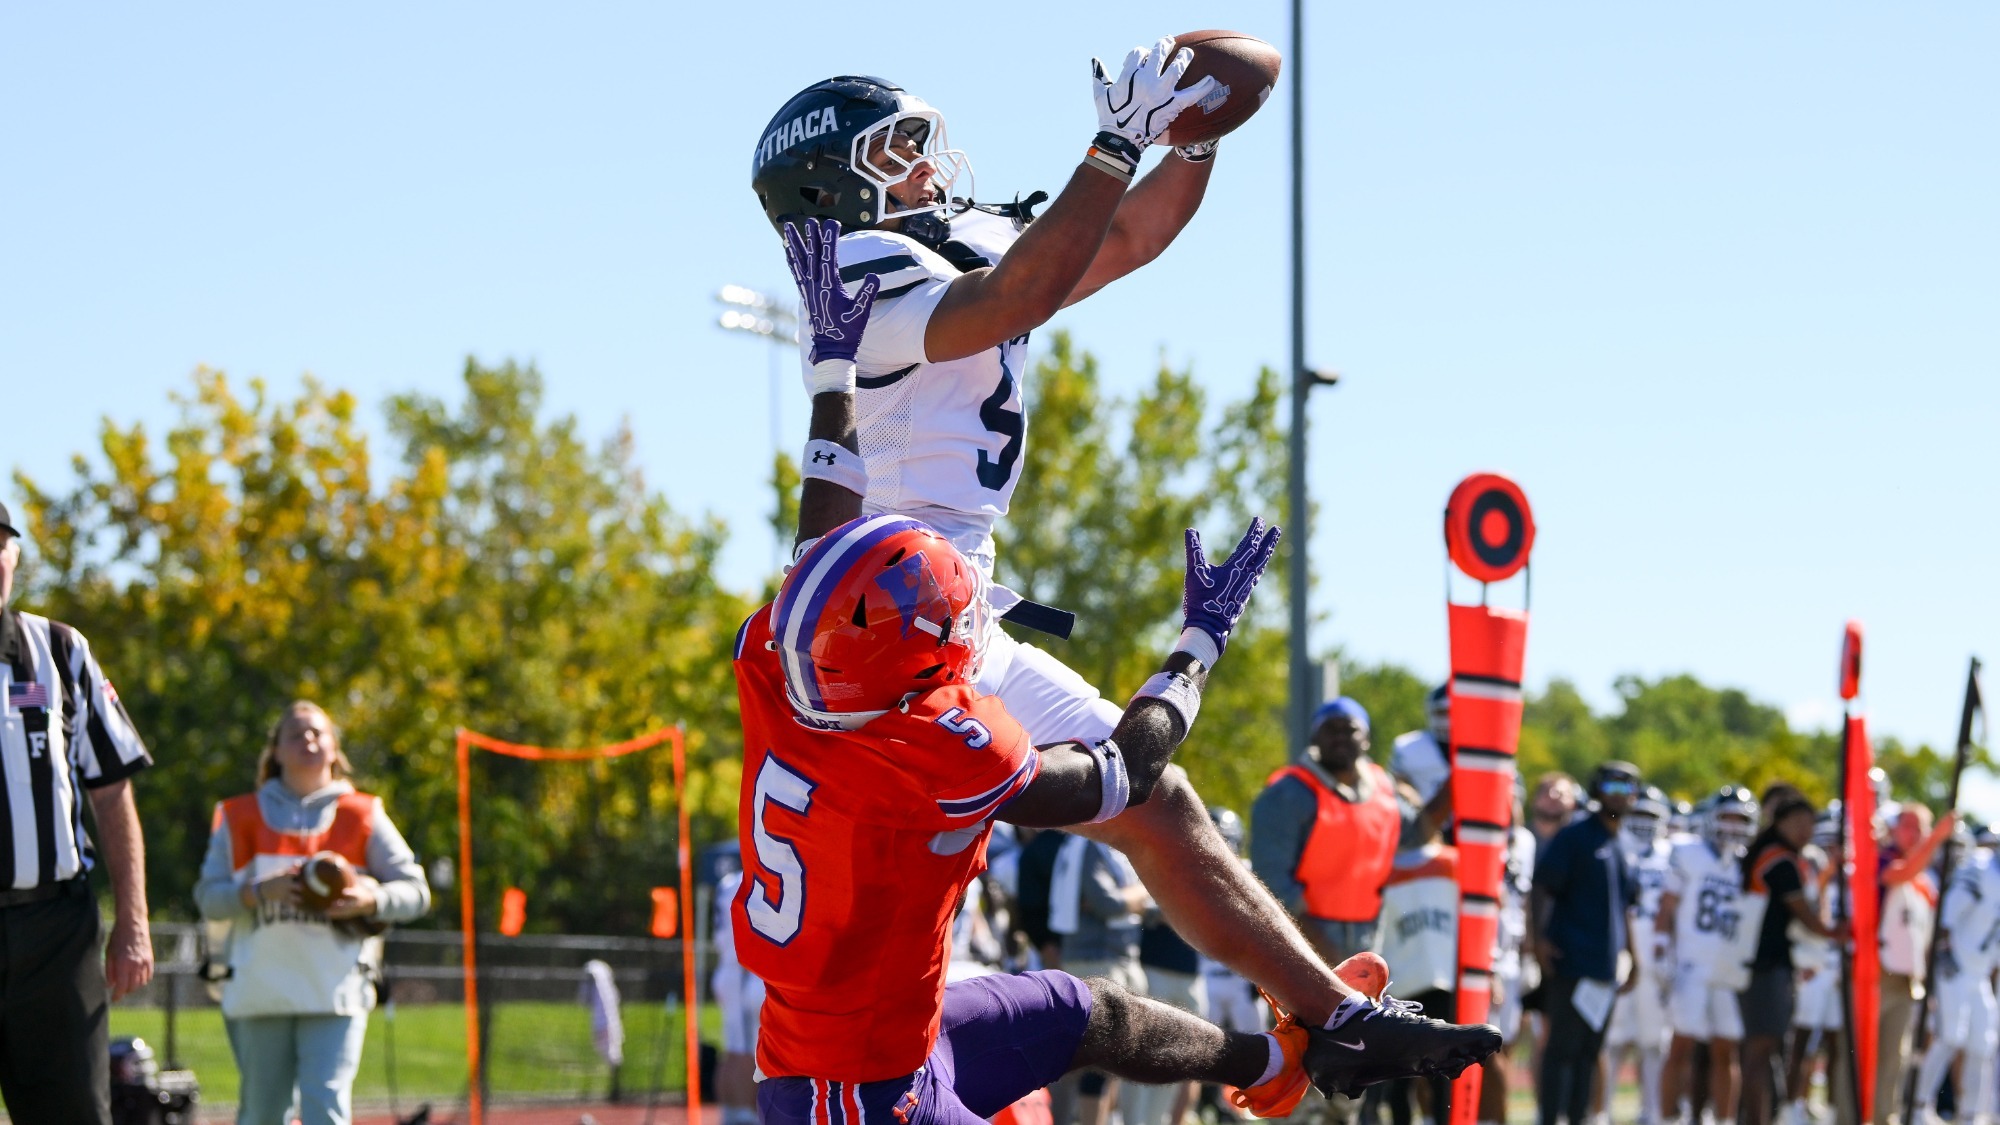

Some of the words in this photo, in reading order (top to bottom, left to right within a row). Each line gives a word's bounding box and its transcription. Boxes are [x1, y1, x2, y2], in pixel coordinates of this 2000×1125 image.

[760, 106, 840, 168] ITHACA
[976, 352, 1025, 491] 5
[29, 731, 47, 758] F
[934, 706, 993, 750] 5
[745, 748, 819, 949] 5
